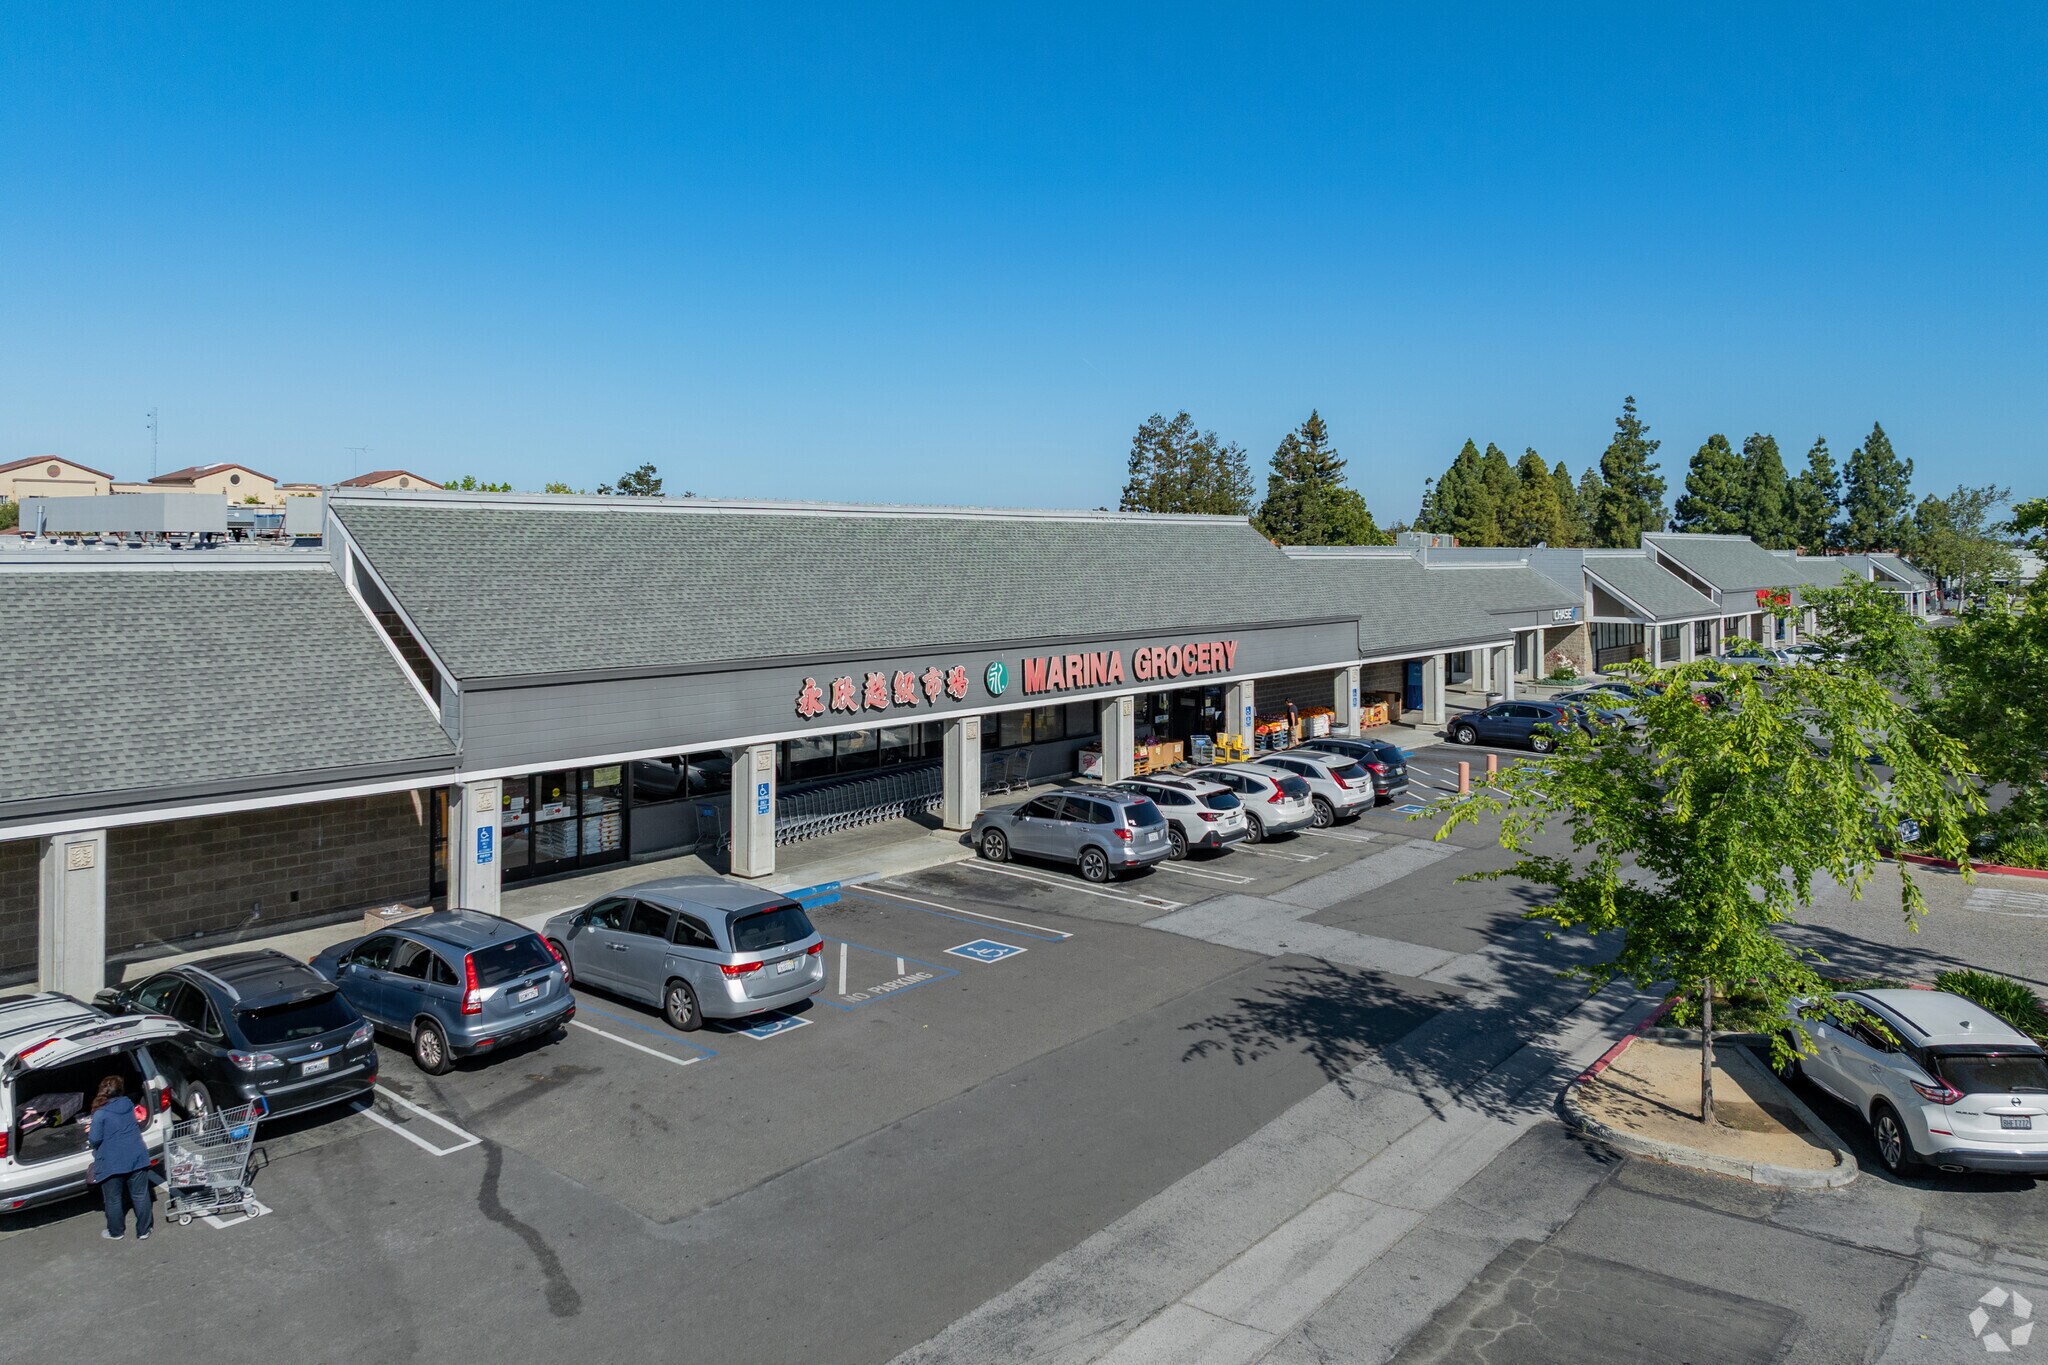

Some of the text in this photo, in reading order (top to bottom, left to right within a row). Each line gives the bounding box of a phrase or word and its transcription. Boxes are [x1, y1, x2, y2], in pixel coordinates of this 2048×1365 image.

[1554, 608, 1572, 620] CHASE
[1024, 640, 1238, 693] MARINA GROCERY
[841, 971, 933, 1003] NO PARKING
